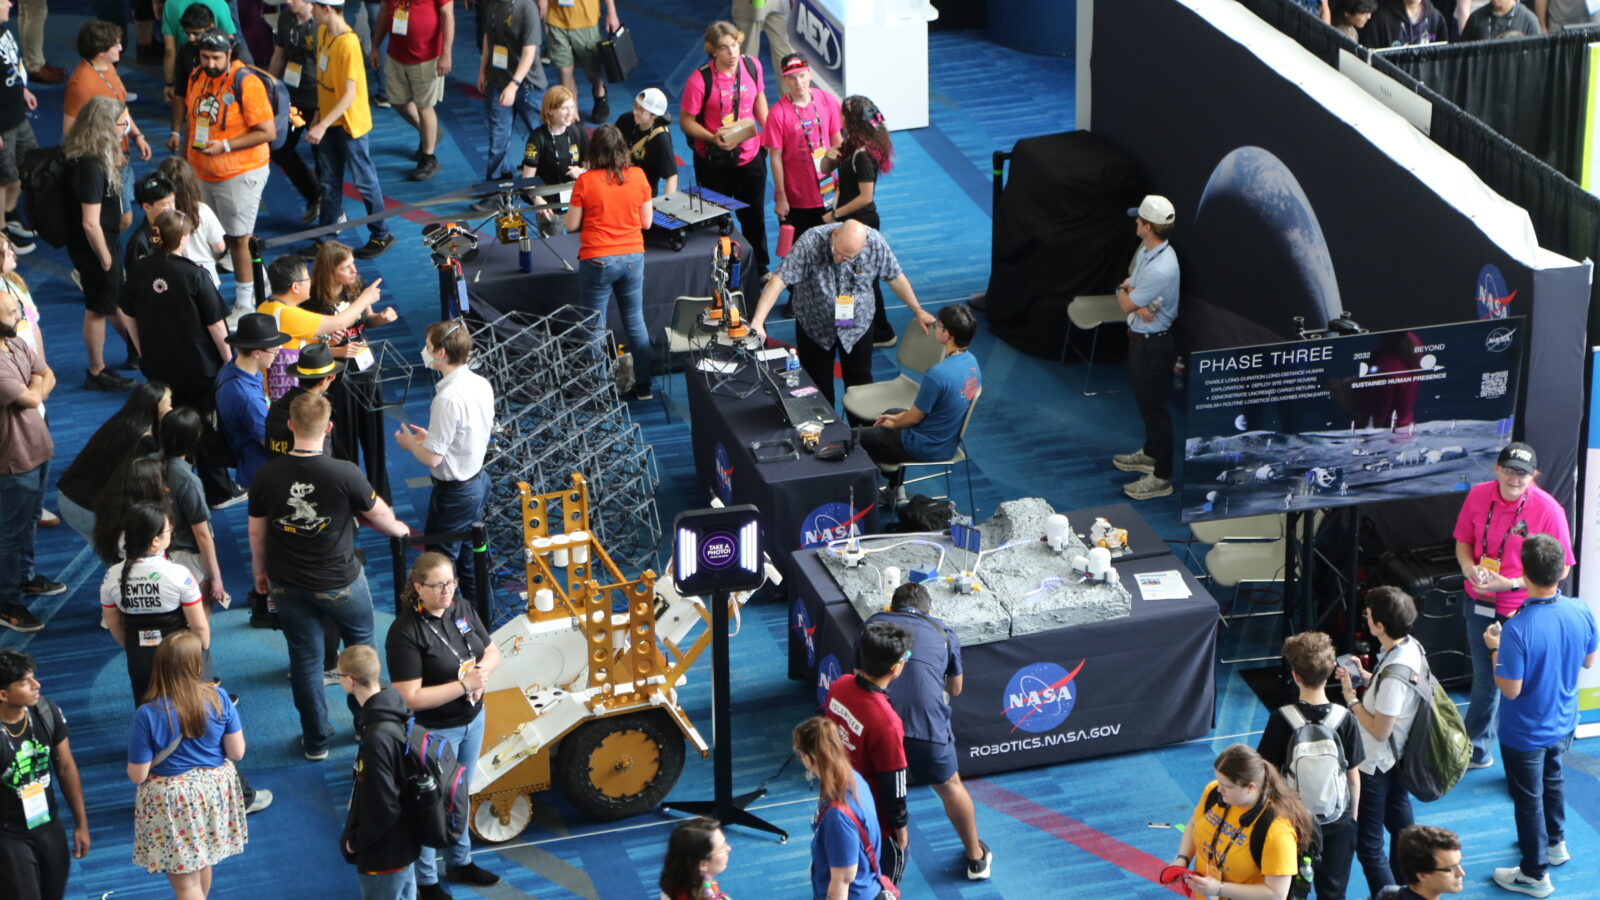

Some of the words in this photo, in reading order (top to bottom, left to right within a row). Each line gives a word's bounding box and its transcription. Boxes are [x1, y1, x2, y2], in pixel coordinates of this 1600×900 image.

[1480, 285, 1508, 320] NASA
[1414, 343, 1446, 353] BEYOND
[1199, 354, 1263, 373] PHASE
[1270, 346, 1334, 366] THREE
[1353, 352, 1371, 360] 2032
[1351, 380, 1387, 389] SUSTAINED
[1387, 377, 1412, 385] HUMAN
[1412, 372, 1447, 382] PRESENCE
[1211, 384, 1244, 393] EXPLORATION
[1211, 391, 1247, 400] DEMONSTRATE
[1195, 402, 1222, 410] ESTABLISH
[1244, 397, 1270, 405] LOGISTICS
[805, 524, 862, 545] NASA
[708, 548, 731, 556] PHOTO!
[125, 583, 160, 596] EWTON
[127, 597, 162, 608] USTERS
[1009, 686, 1073, 710] NASA
[970, 723, 1122, 758] ROBOTICS.NASA.GOV
